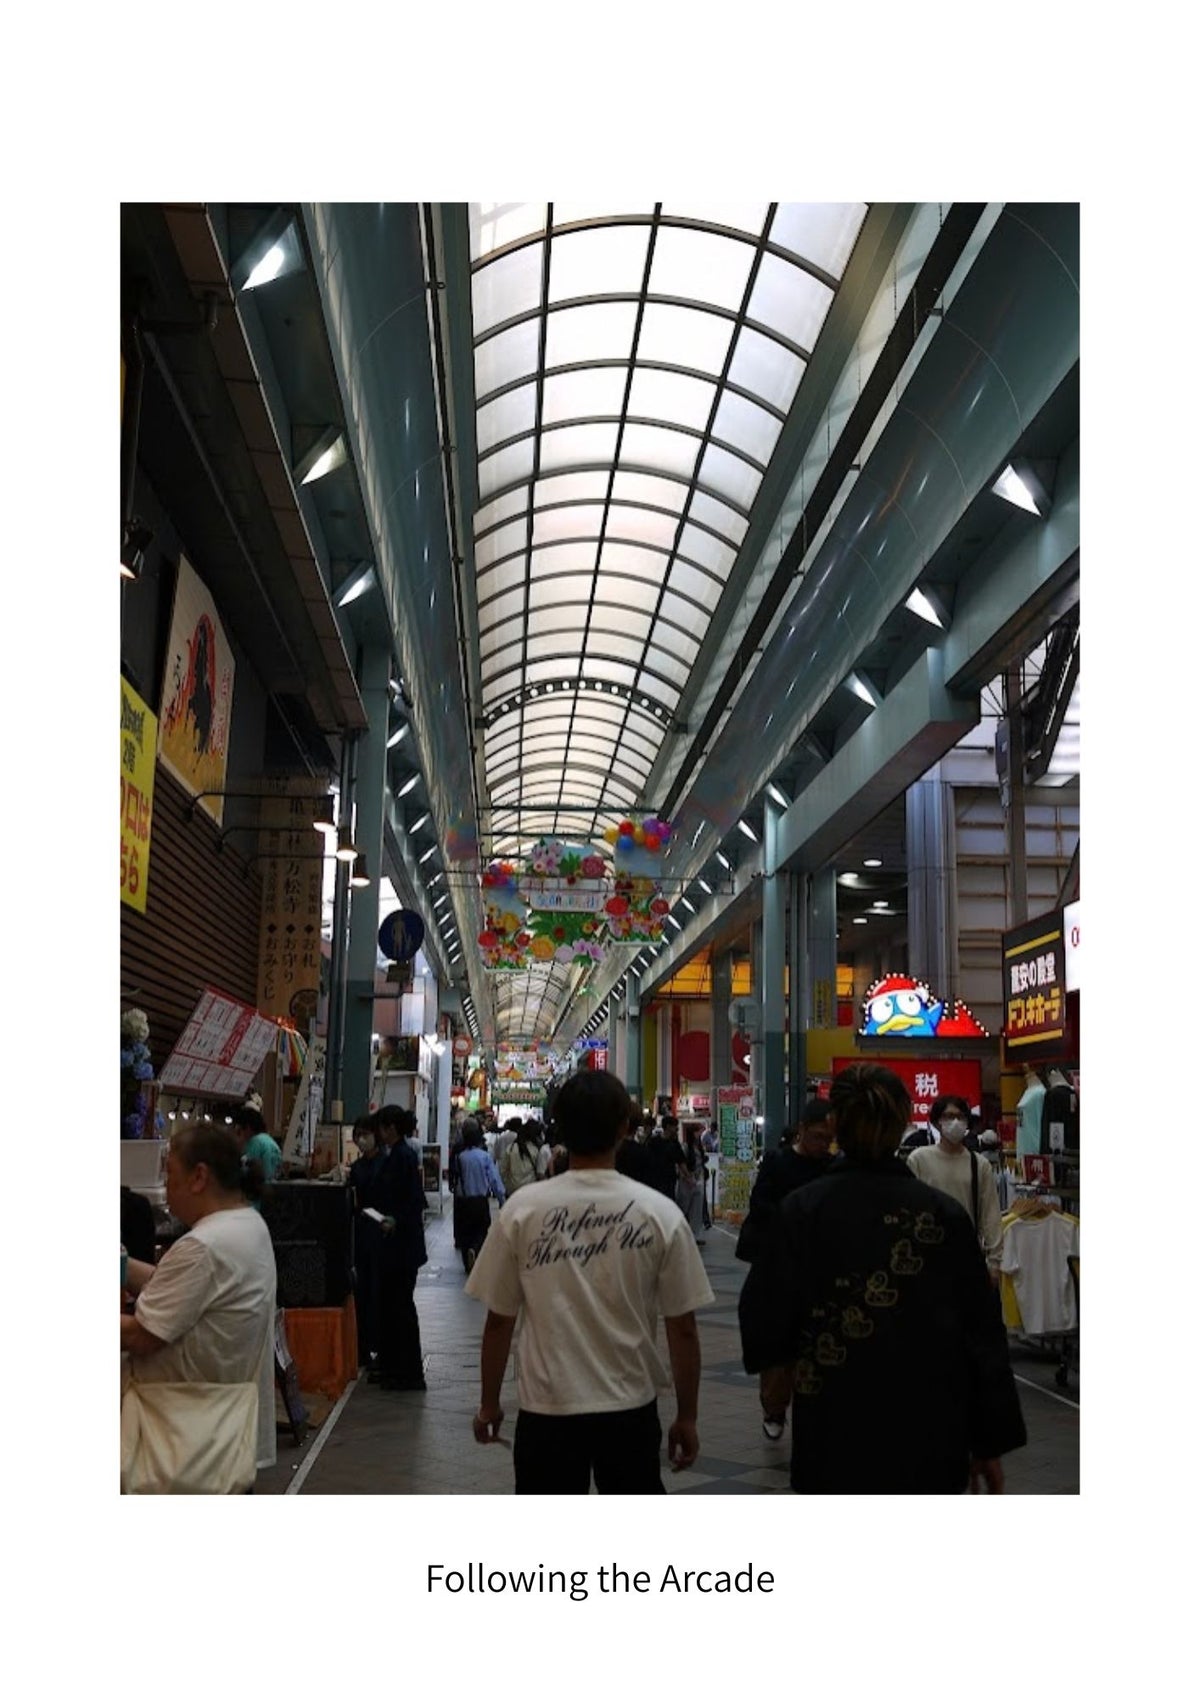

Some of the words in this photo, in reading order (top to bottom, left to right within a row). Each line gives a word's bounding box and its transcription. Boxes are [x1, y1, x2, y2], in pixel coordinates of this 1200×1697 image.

[263, 937, 279, 1000] おみくじ
[541, 1200, 635, 1240] Refined
[526, 1226, 615, 1269] Through
[617, 1221, 654, 1249] Use
